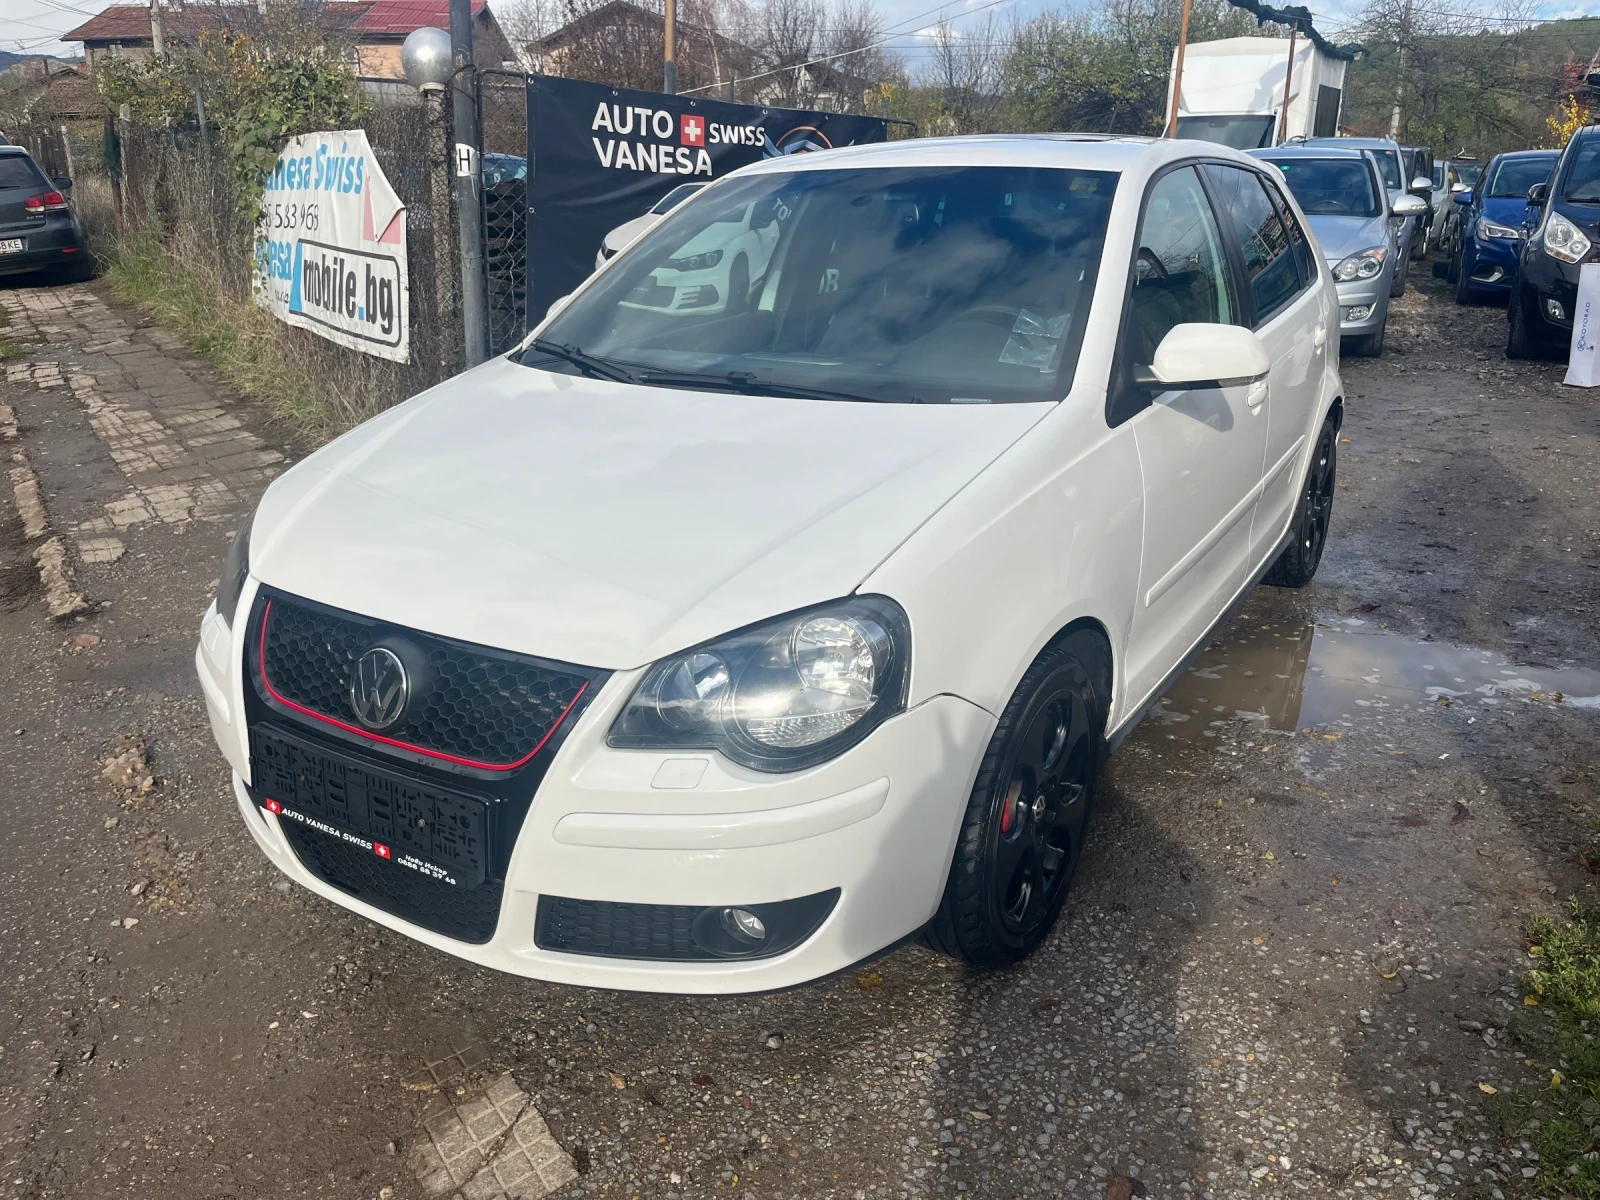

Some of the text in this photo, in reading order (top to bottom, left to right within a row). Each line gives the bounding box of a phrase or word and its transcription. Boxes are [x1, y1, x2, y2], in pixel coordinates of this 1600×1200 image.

[592, 102, 674, 139] AUTO
[709, 122, 765, 147] SWISS
[314, 142, 364, 194] Swiss
[592, 137, 713, 176] VANESA
[303, 253, 393, 335] mobile.bg
[281, 808, 372, 849] AUTO VANESA SWISS
